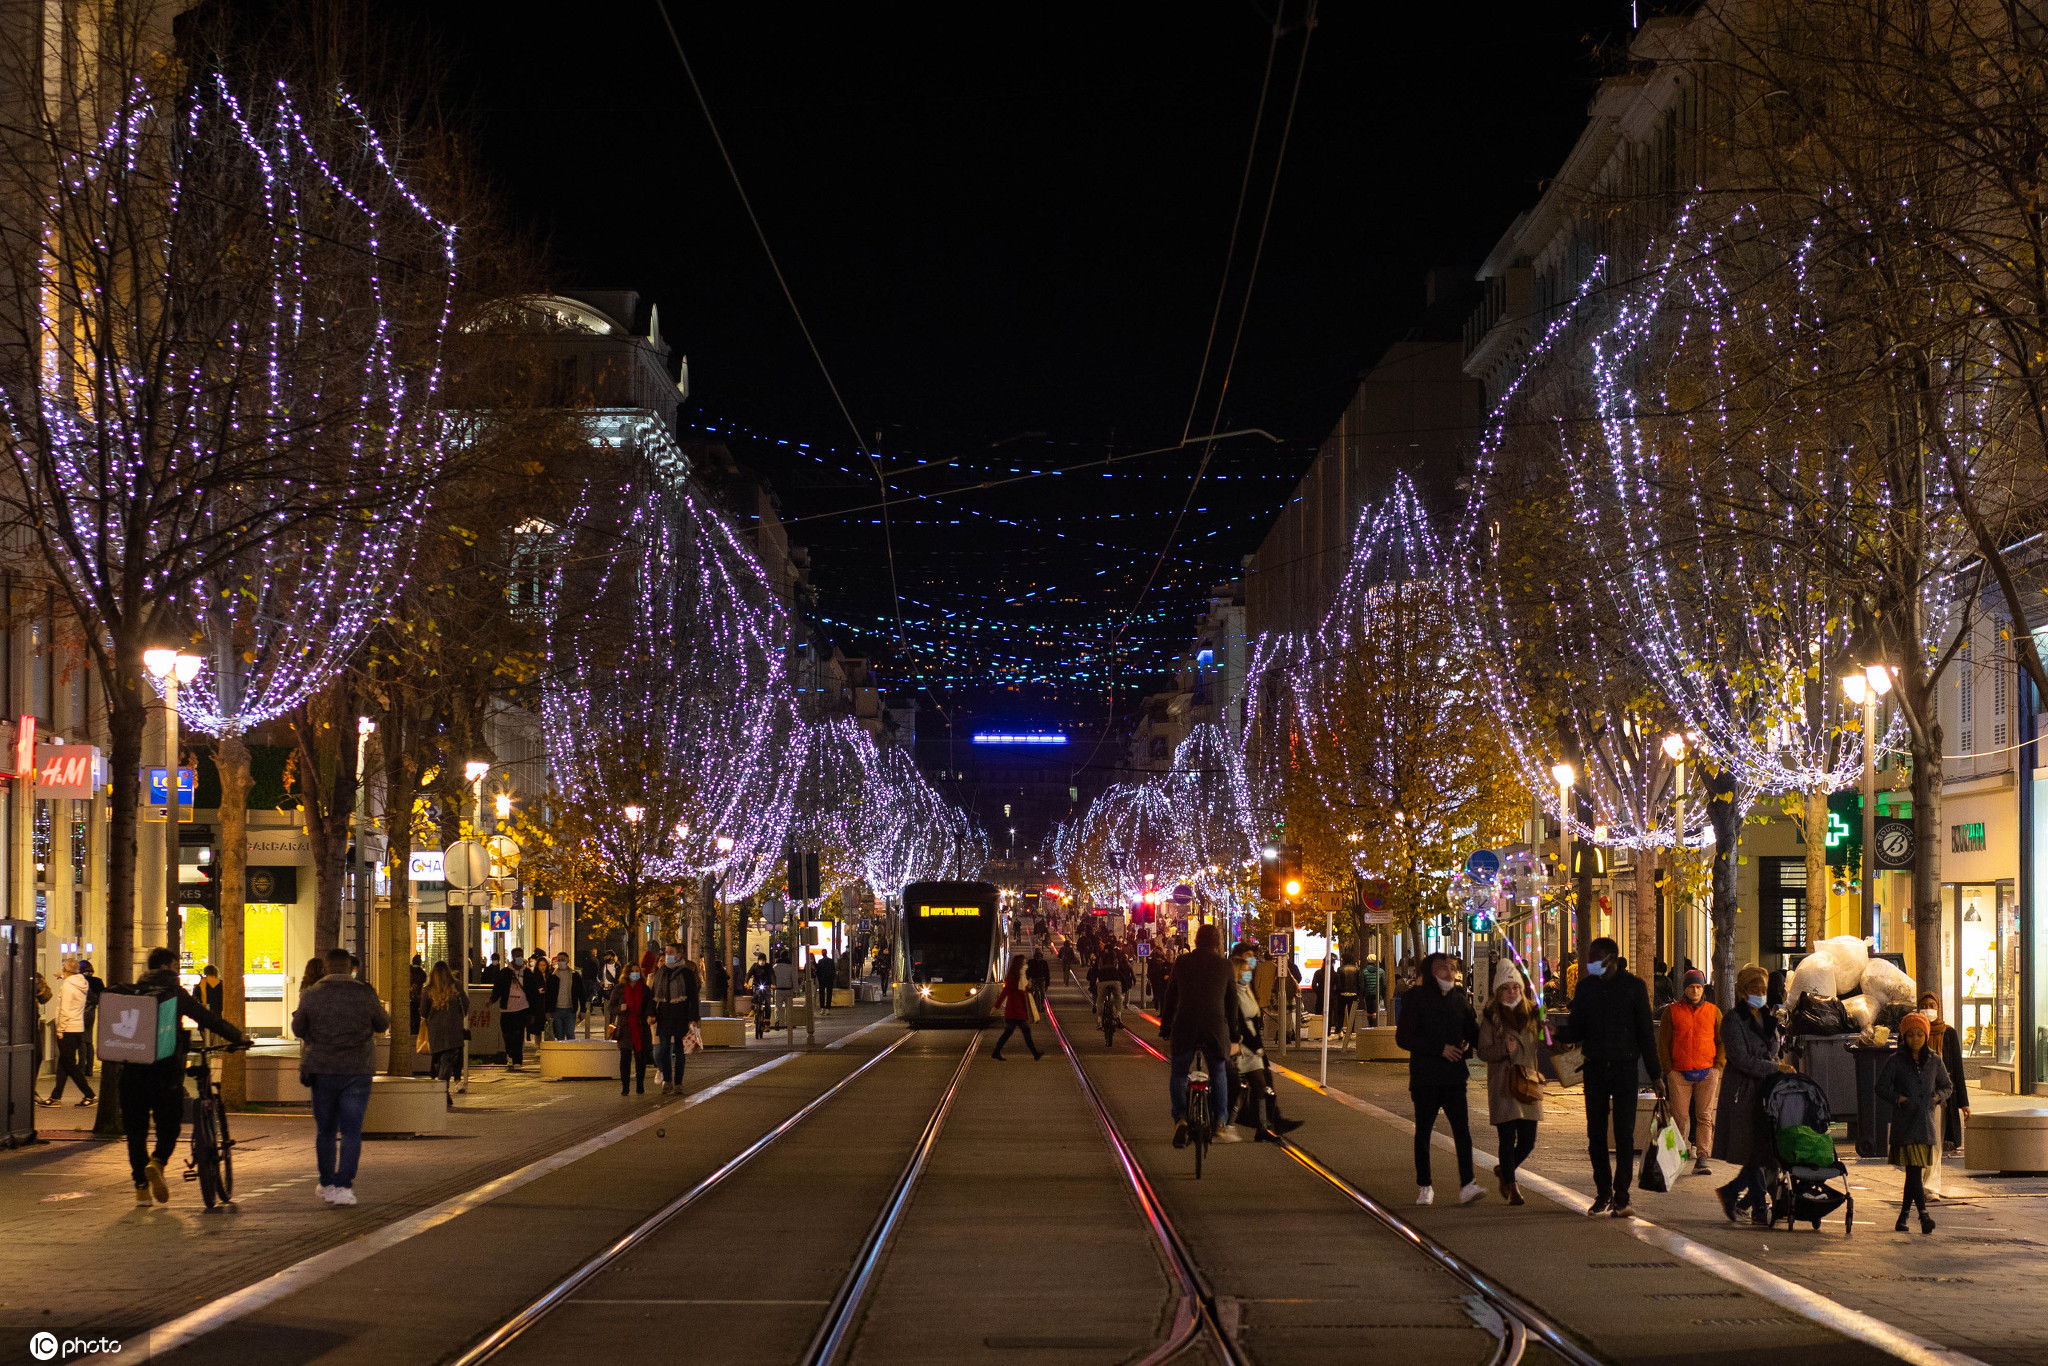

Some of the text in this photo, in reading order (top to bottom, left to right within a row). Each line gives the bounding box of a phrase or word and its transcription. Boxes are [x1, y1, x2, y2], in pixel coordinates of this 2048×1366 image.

[40, 756, 88, 788] H&M
[1878, 825, 1913, 841] BOUCHARA
[954, 907, 979, 916] PASTEUR
